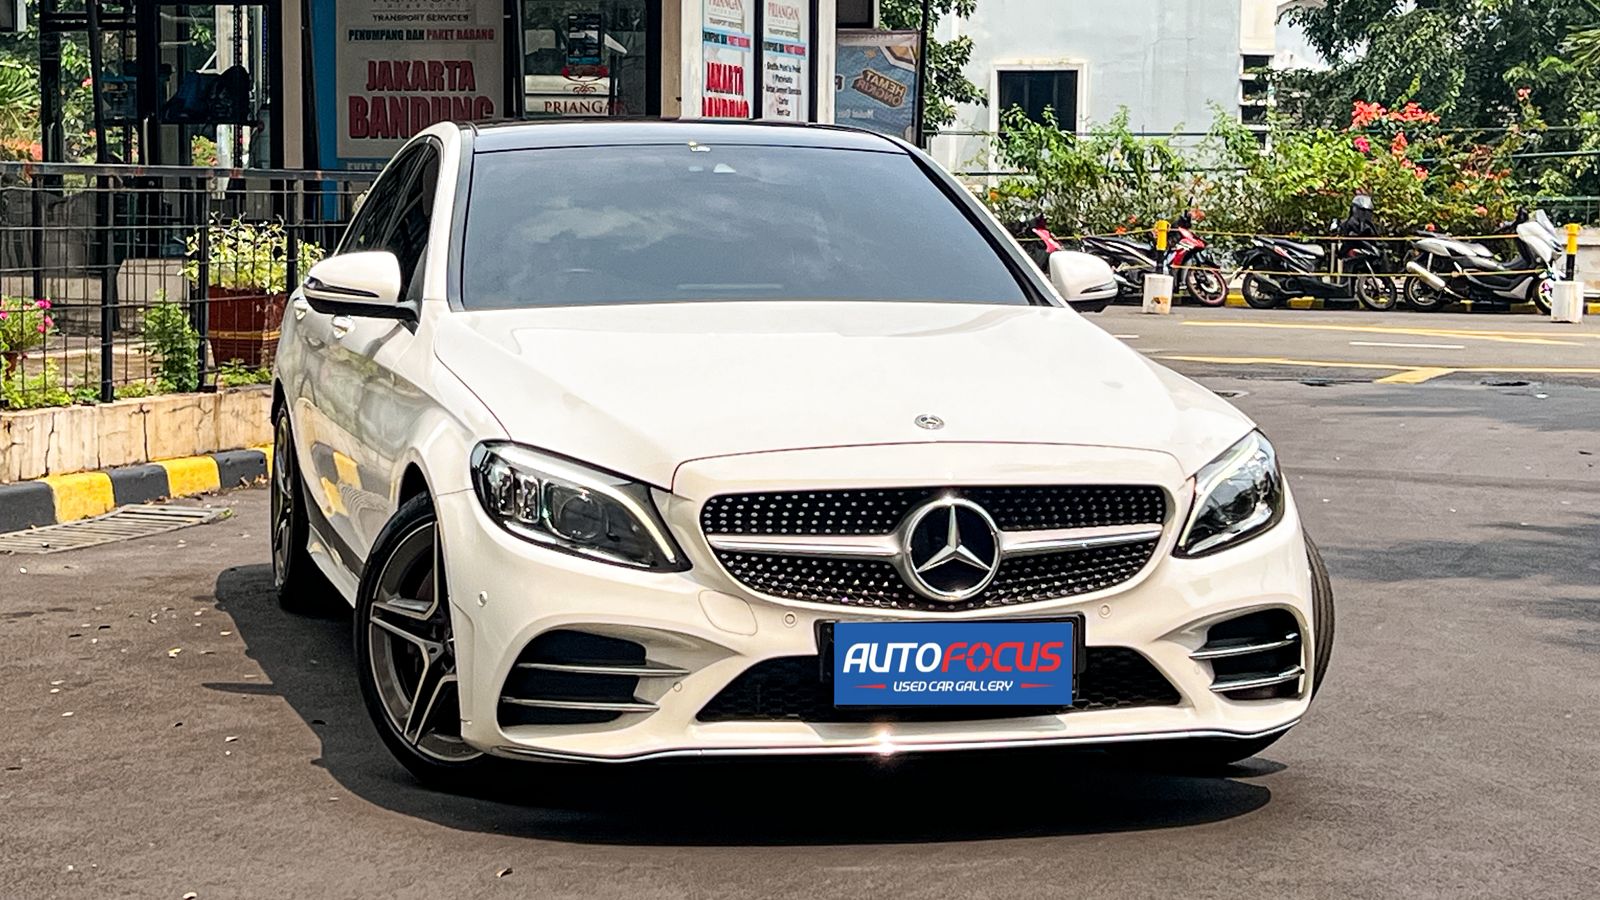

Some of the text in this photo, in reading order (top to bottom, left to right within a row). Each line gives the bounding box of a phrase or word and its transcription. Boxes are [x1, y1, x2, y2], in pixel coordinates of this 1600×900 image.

[372, 14, 470, 22] TRANSPORT SERVICES
[348, 29, 495, 42] PENUMPANG DAN PAKET BARANG
[365, 60, 477, 92] JAKARTA
[706, 61, 744, 96] JAKARTA
[348, 95, 495, 139] BANDUNG
